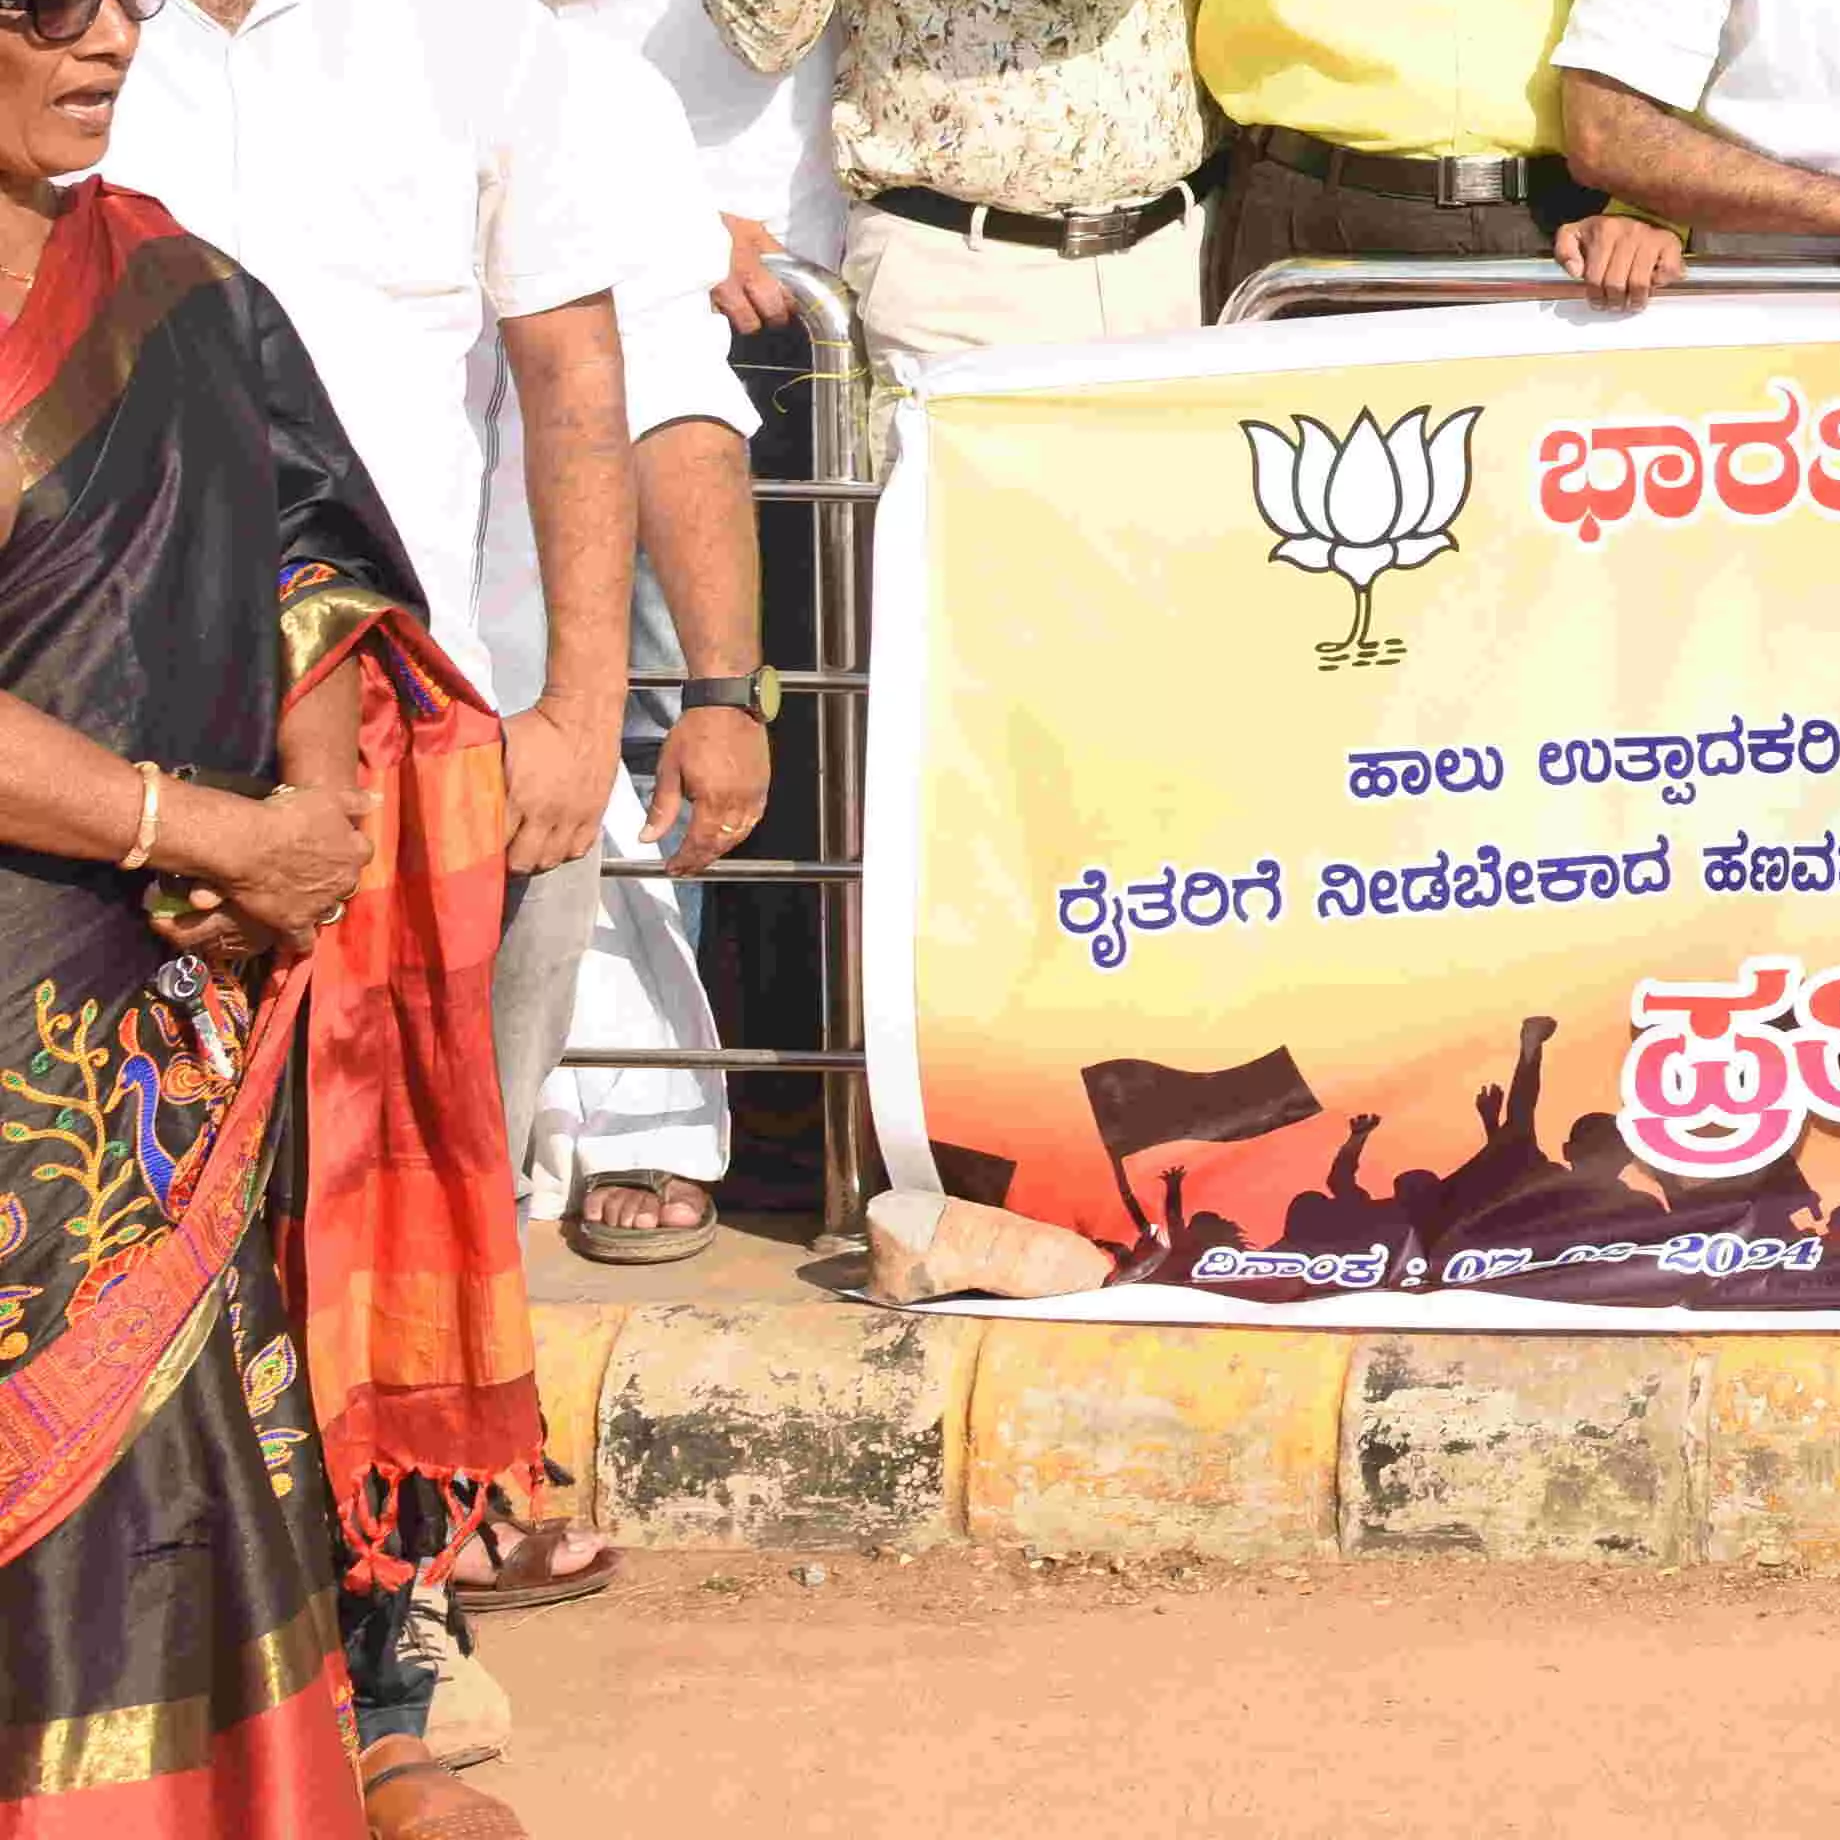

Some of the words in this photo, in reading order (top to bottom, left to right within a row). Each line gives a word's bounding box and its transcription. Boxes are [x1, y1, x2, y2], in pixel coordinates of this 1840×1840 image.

[1348, 744, 1504, 799] ಹಾಲು
[1058, 858, 1282, 969] ರೈತರಿಗೆ
[1316, 834, 1670, 920] ನೀಡಬೇಕಾದ
[1193, 1245, 1387, 1289] ದಿನಾಂಕ
